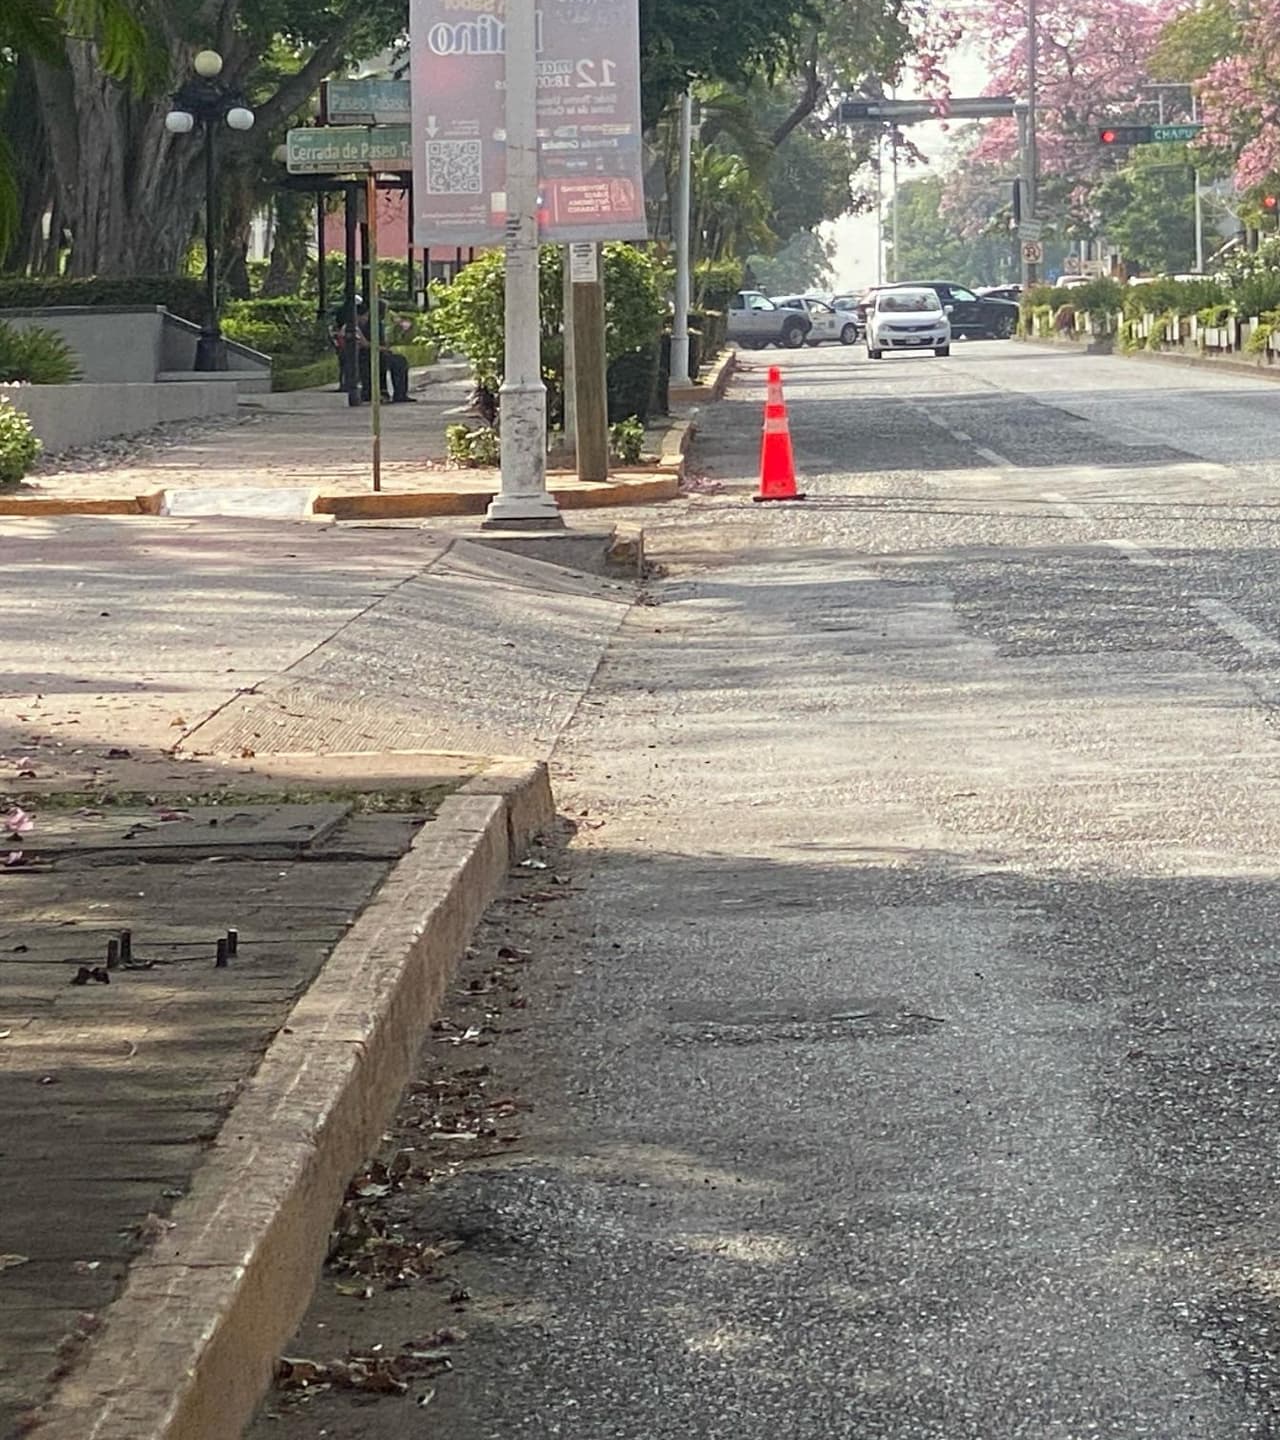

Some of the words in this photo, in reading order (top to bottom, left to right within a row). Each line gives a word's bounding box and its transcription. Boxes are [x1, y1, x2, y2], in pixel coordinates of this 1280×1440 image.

[331, 93, 368, 110] Paseo
[291, 143, 340, 161] Cerrada
[342, 142, 358, 159] de
[361, 142, 397, 159] Paseo
